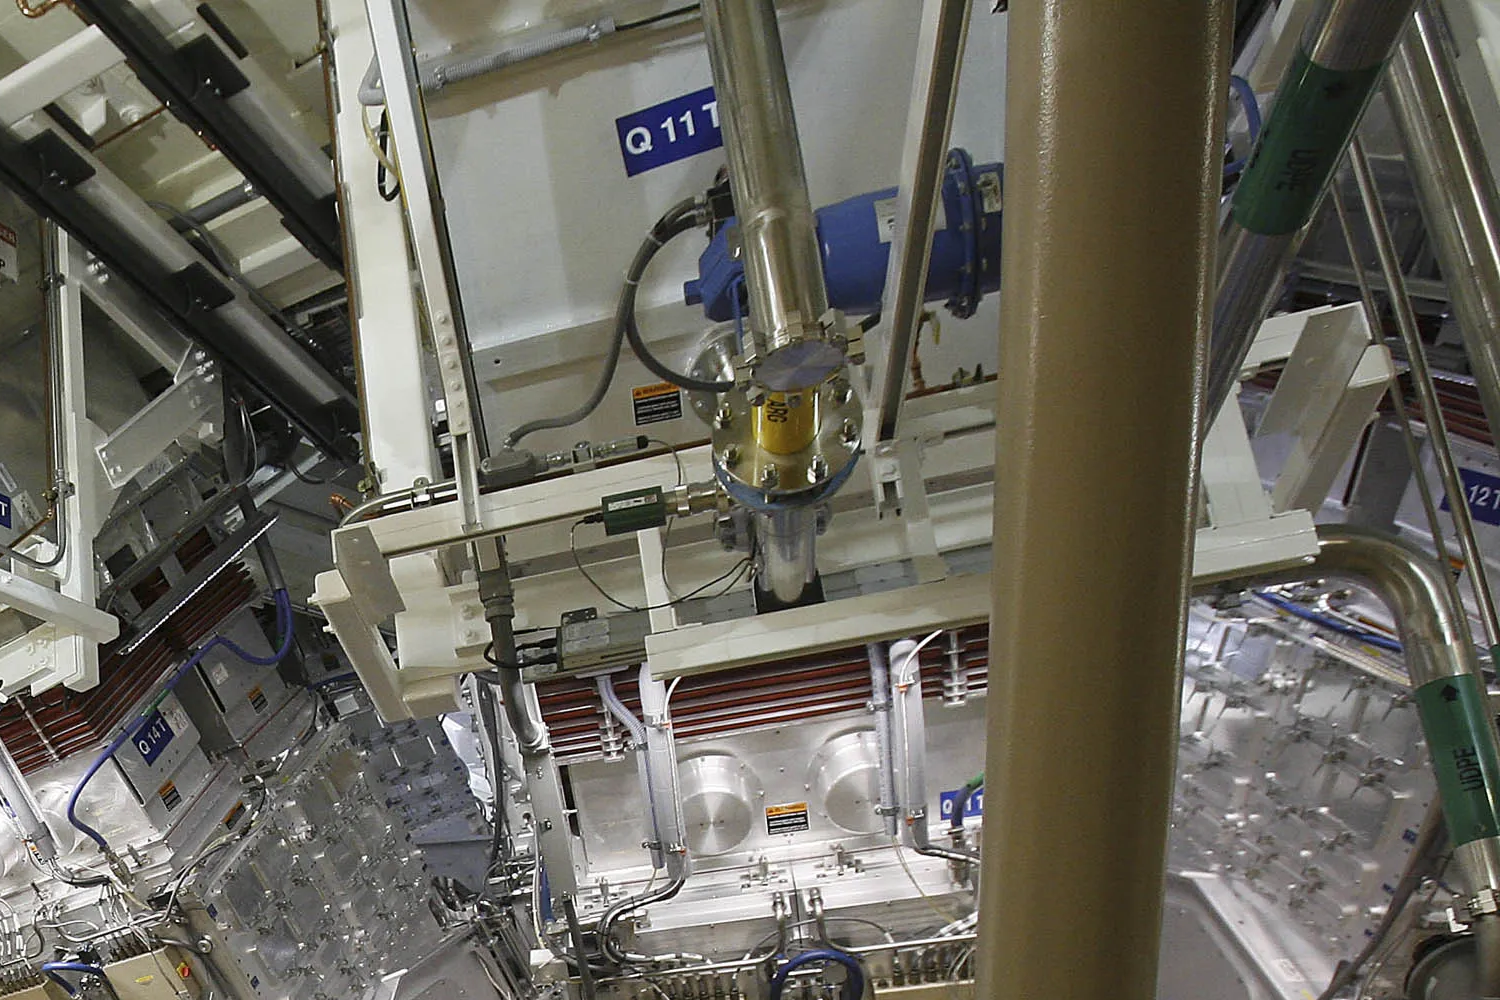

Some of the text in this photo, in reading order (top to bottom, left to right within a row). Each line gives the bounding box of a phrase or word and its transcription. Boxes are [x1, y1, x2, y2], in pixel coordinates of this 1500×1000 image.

[626, 127, 653, 155] Q
[660, 109, 695, 143] 11
[139, 739, 151, 755] Q
